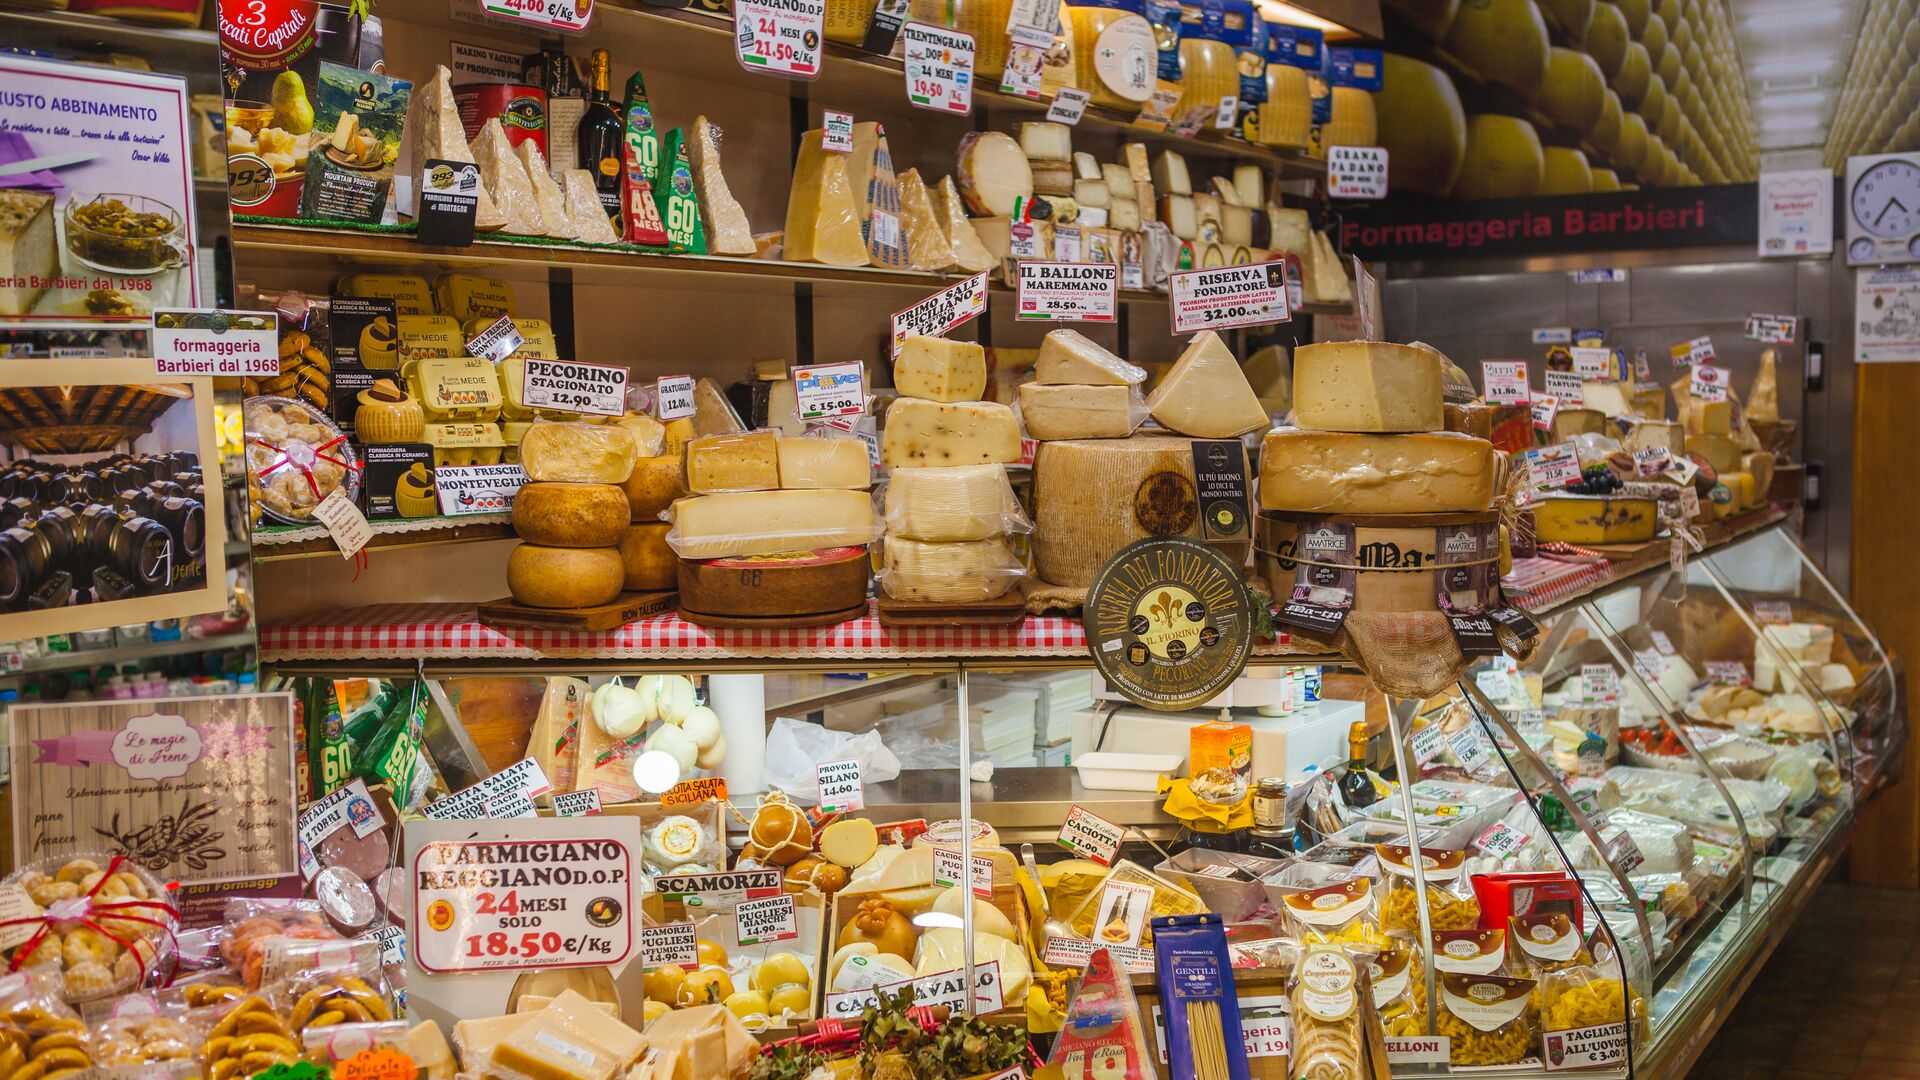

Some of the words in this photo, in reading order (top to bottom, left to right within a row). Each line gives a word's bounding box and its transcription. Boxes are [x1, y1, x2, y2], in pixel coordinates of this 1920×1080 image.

[246, 1, 266, 25] 3
[254, 9, 306, 50] Capitali
[758, 17, 777, 37] 24
[780, 26, 801, 40] MESI
[904, 28, 975, 52] TRENTINGRANA
[456, 46, 488, 59] MAKING
[755, 39, 793, 61] 21.50
[925, 47, 943, 60] DOP
[454, 61, 465, 70] OF
[466, 63, 507, 79] PRODUCTS
[921, 64, 932, 77] 24
[935, 67, 953, 80] MESI
[914, 79, 943, 97] 19.50
[50, 97, 157, 121] ABBINAMENTO
[1336, 149, 1379, 162] GRANA
[1331, 162, 1385, 174] PADANO
[323, 172, 354, 183] MOUNTAIN
[355, 176, 377, 188] PRODUCT
[431, 171, 453, 182] 993
[424, 194, 453, 205] PARMIGIANO
[453, 196, 476, 205] REGGIANO
[631, 189, 660, 223] 48
[438, 204, 467, 214] MONTAGNA
[668, 196, 695, 234] 60
[633, 218, 664, 234] MESI
[1342, 212, 1552, 250] Formaggeria
[1564, 201, 1705, 237] Barbieri
[667, 231, 695, 247] MESI
[1020, 267, 1037, 280] IL
[1040, 267, 1116, 281] BALLONE
[1198, 267, 1263, 286] RISERVA
[31, 275, 87, 290] Barbieri
[92, 277, 114, 290] dal
[119, 278, 153, 291] 1968
[1026, 280, 1108, 293] MAREMMANO
[1193, 280, 1267, 298] FONDATORE
[332, 299, 370, 309] FORMAGGIERA
[393, 293, 420, 302] MEDIE
[485, 294, 509, 304] MEDIE
[897, 298, 939, 326] PRIMO
[944, 276, 980, 301] SALE
[1179, 297, 1208, 307] PECORINO
[1208, 295, 1238, 304] PRODOTTO
[1238, 293, 1251, 301] CON
[1252, 291, 1269, 299] LATTE
[1182, 303, 1207, 312] MAREMMA
[1217, 299, 1249, 308] ALTISSIMA
[332, 304, 358, 312] CLASSICA
[358, 305, 364, 313] IN
[364, 306, 391, 315] CERAMICA
[905, 290, 974, 330] SICILIANO
[1046, 301, 1076, 312] 28.50
[1203, 306, 1246, 322] 32.00
[421, 333, 449, 342] MEDIE
[467, 335, 487, 351] UOVA
[486, 318, 510, 339] FRESCHE
[472, 323, 517, 358] MONTEVEGLIO
[173, 338, 261, 355] formaggeria
[157, 359, 215, 373] Barbieri
[219, 359, 241, 373] dal
[244, 359, 279, 373] 1968
[527, 361, 625, 384] PECORINO
[460, 376, 487, 386] MEDIE
[797, 372, 860, 393] piave
[1547, 373, 1582, 382] PECORINO
[1547, 380, 1581, 390] TARTUFO
[530, 377, 614, 395] STAGIONATO
[551, 392, 591, 407] 12.90
[819, 399, 852, 412] 15.00
[368, 447, 407, 455] FORMAGGIERA
[435, 466, 467, 479] UOVA
[1198, 474, 1205, 483] IL
[438, 476, 530, 493] MONTEVEGLIO
[1201, 490, 1220, 498] MONDO
[1306, 537, 1345, 550] AMATRICE
[1446, 541, 1477, 552] AMATRICE
[1098, 579, 1134, 638] RISERVA
[1123, 556, 1157, 597] DEL
[1156, 549, 1239, 614] FONDATORE
[622, 607, 638, 621] BON
[1146, 636, 1157, 646] IL
[1158, 627, 1200, 643] FIORINO
[1153, 656, 1211, 683] PECORINO
[124, 731, 146, 748] Le
[149, 733, 188, 752] magie
[129, 752, 145, 764] di
[149, 749, 190, 764] Irene
[321, 745, 353, 786] 60
[819, 762, 858, 775] PROVOLA
[423, 785, 483, 815] RICOTTA
[482, 758, 535, 789] SALATA
[692, 777, 726, 791] SALATA
[818, 771, 859, 787] SILANO
[433, 791, 491, 820] SICILIANA
[491, 772, 530, 795] SARDA
[554, 790, 596, 803] RICOTTA
[666, 787, 718, 806] SICILIANA
[823, 784, 853, 797] 14.60
[489, 797, 530, 818] RICOTTA
[490, 792, 519, 808] CACIO
[557, 797, 595, 810] SALATA
[561, 804, 593, 816] SARDA
[305, 832, 313, 843] 2
[312, 809, 342, 834] TORRI
[1067, 818, 1119, 849] CACIOTTA
[1069, 834, 1098, 854] 11.00
[436, 843, 621, 868] PARMIGIANO
[214, 878, 279, 895] Formaggi
[419, 867, 571, 891] REGGIANO
[572, 869, 629, 886] D.O.P.
[656, 872, 779, 894] SCAMORZE
[1106, 882, 1152, 895] TORTELLINI
[475, 890, 519, 916] 24
[519, 897, 567, 914] MESI
[738, 898, 792, 914] SCAMORZE
[737, 905, 793, 923] PUGLIESI
[743, 914, 787, 929] BIANCHE
[498, 915, 542, 930] SOLO
[746, 924, 776, 936] 14.90
[465, 931, 562, 959] 18.50
[563, 937, 612, 957] €/Kg
[1105, 943, 1133, 952] TRADIZIONE
[648, 952, 678, 963] 14.90
[1175, 967, 1218, 976] GENTILE
[1589, 1052, 1596, 1061] €
[1600, 1049, 1620, 1060] 3.00
